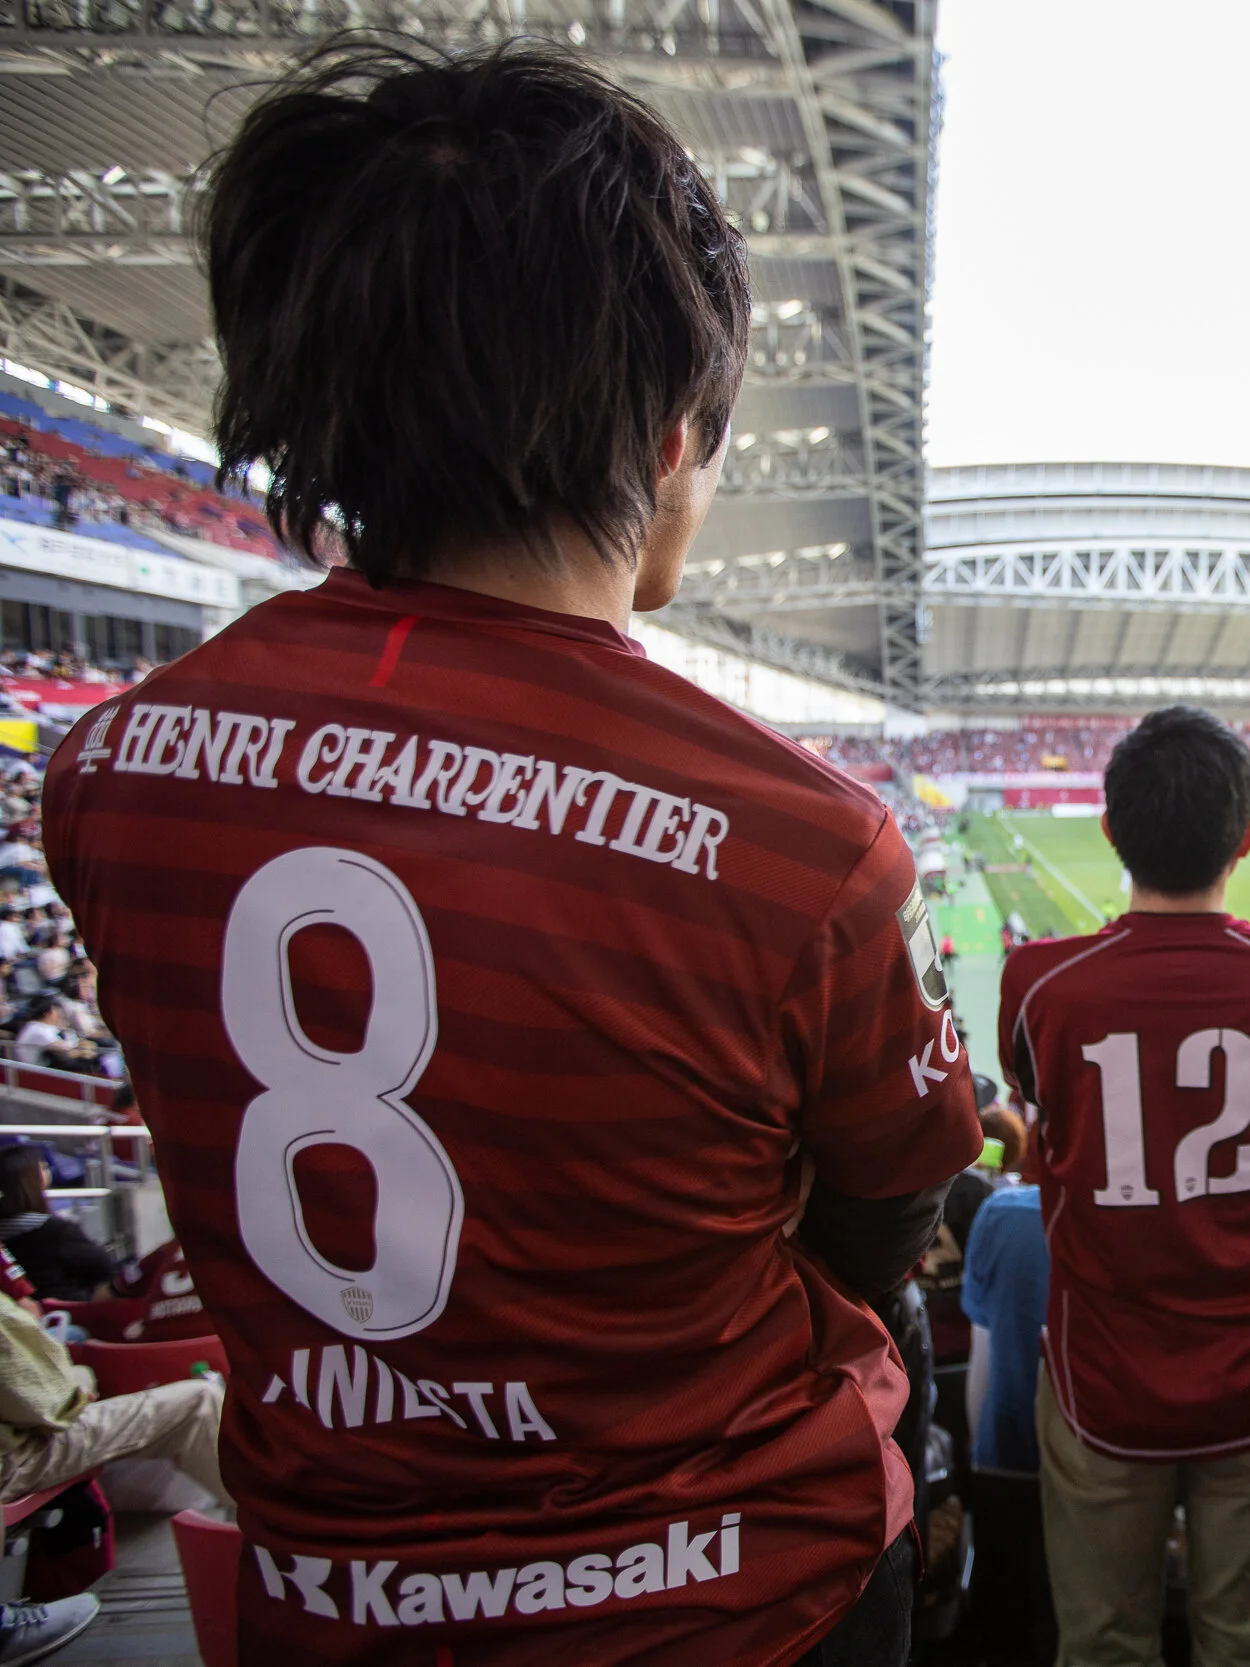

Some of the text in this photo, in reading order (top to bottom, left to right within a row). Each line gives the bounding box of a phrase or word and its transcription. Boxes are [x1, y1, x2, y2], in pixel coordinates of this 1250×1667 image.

[114, 703, 730, 881] HENRI CHARPENTIER
[221, 846, 465, 1341] 8
[351, 1512, 741, 1627] Kawasaki
